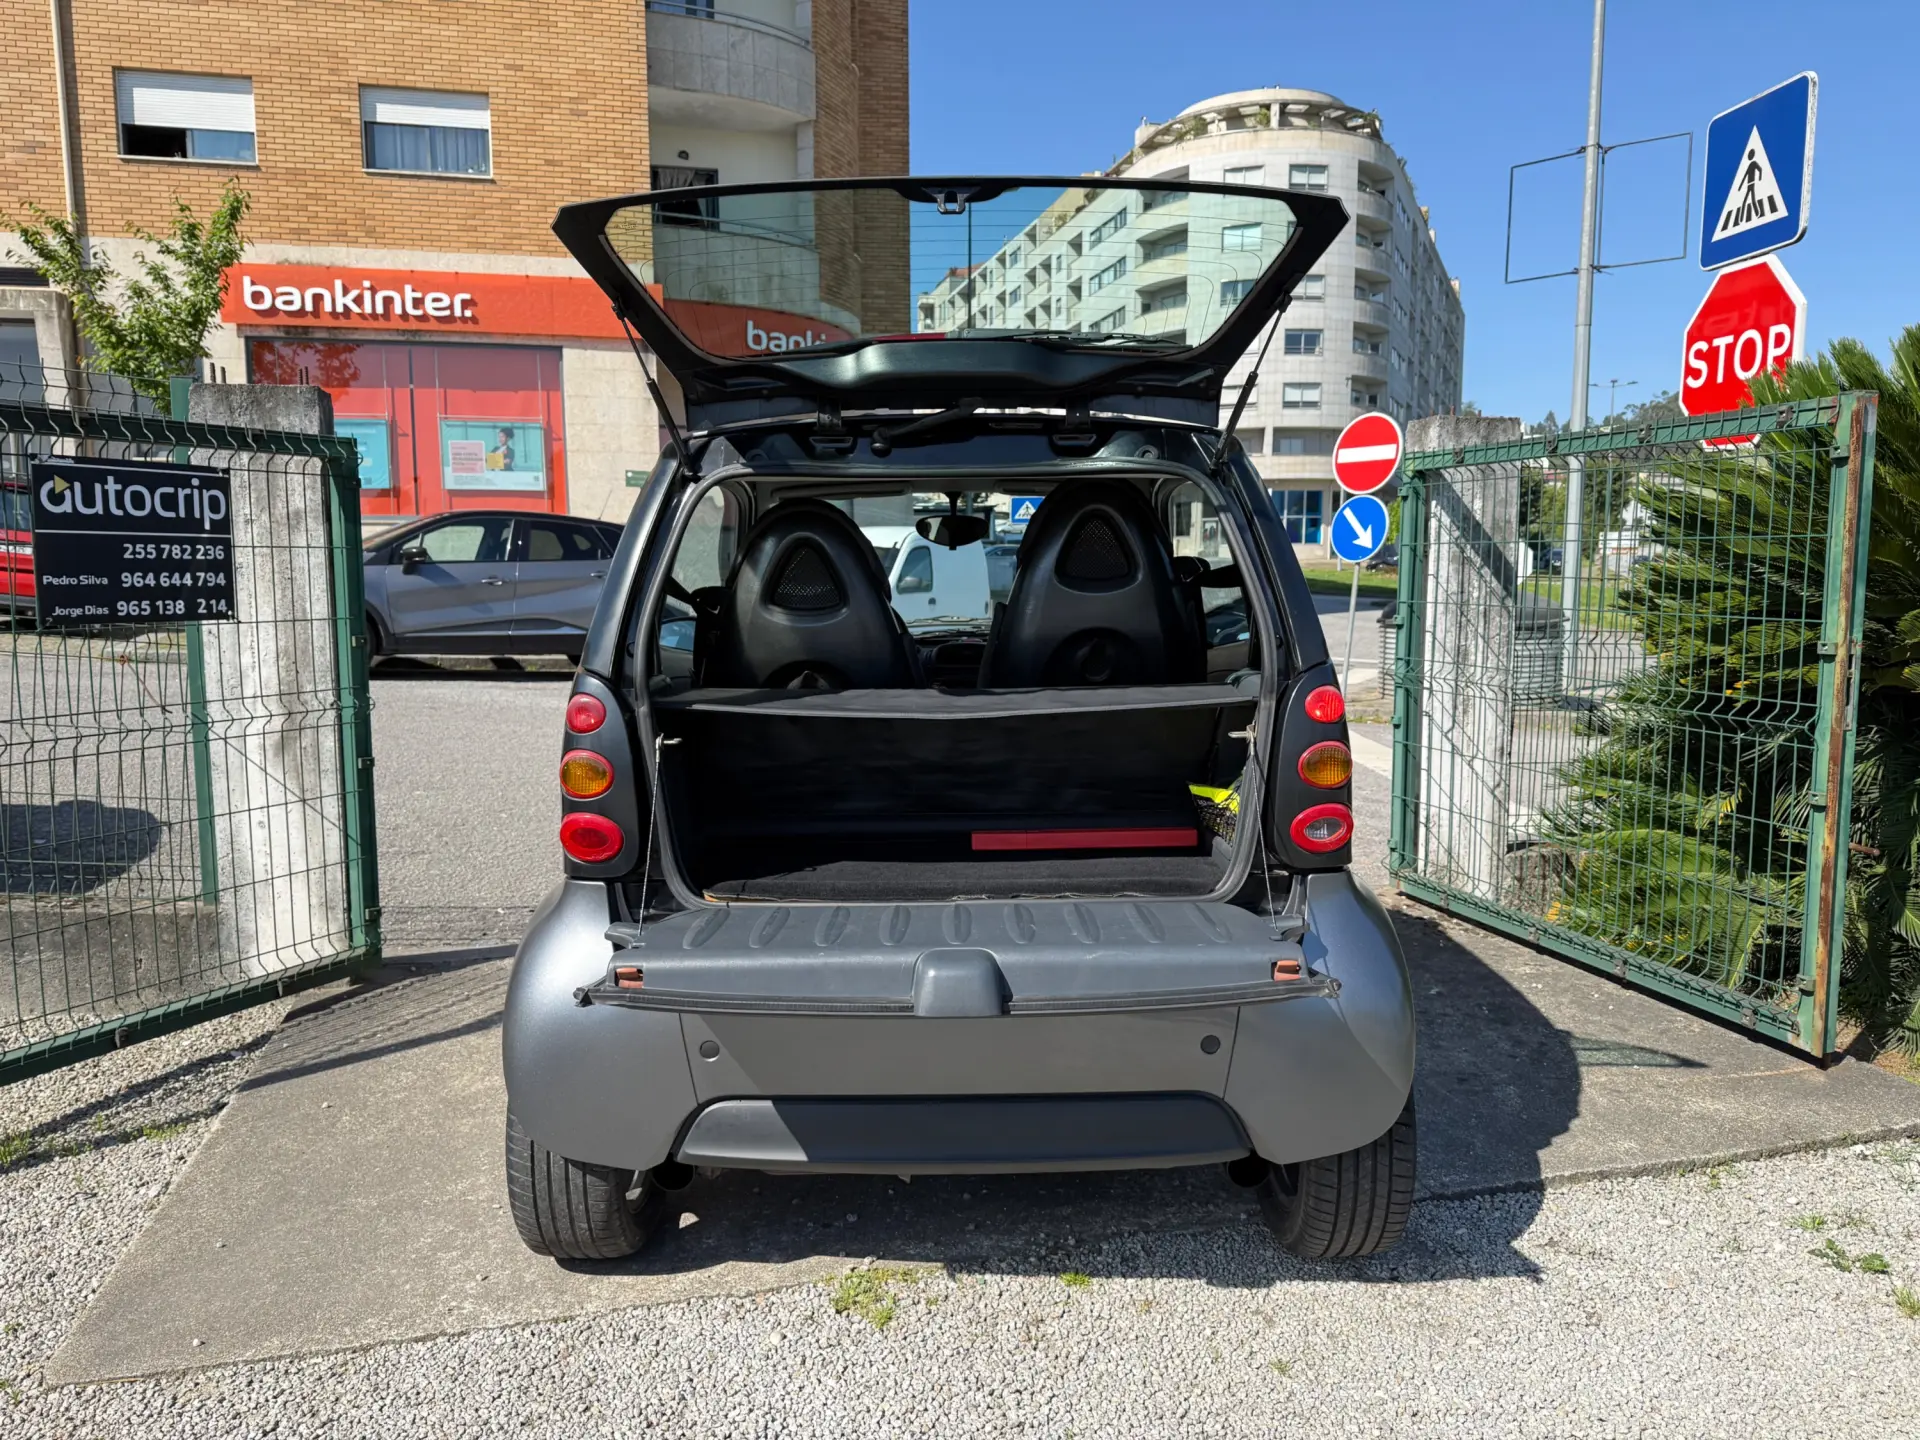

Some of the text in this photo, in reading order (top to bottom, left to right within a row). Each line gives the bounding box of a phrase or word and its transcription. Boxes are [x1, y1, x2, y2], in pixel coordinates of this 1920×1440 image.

[242, 275, 473, 318] bankinter.
[746, 320, 827, 353] bank
[1685, 323, 1792, 389] STOP
[39, 475, 227, 530] autocrip
[123, 544, 225, 561] 255 782 236
[42, 572, 226, 588] Pedro Silva 964 644 794
[52, 599, 227, 618] Jorge Dias 965 138 214
